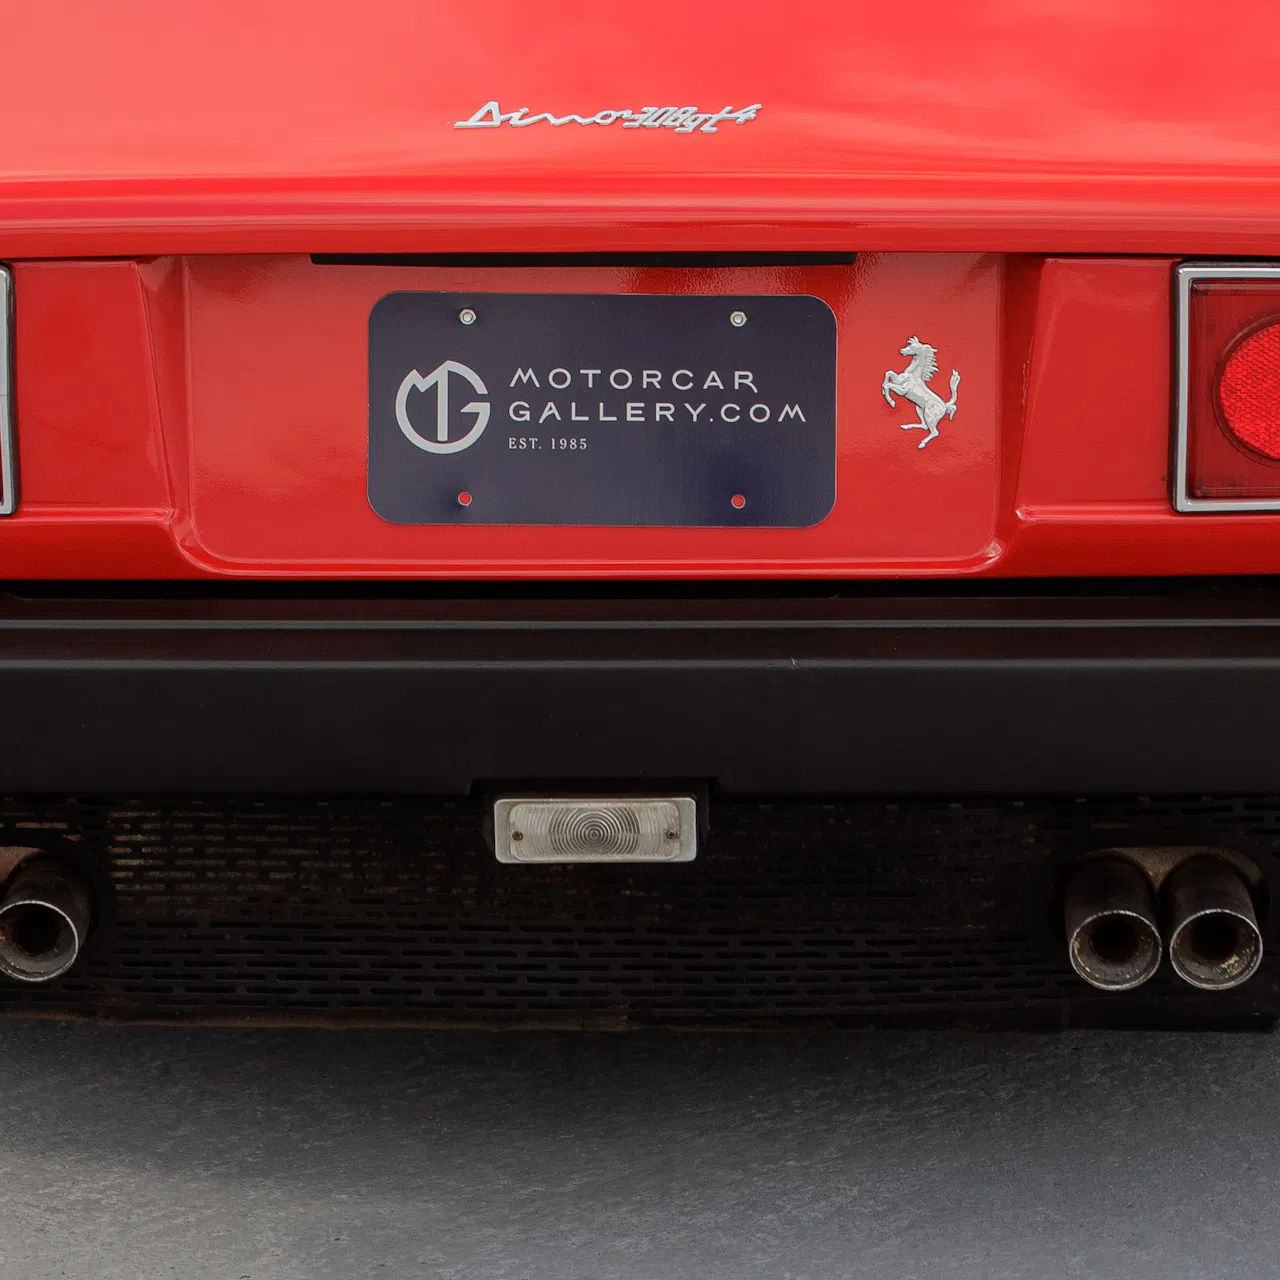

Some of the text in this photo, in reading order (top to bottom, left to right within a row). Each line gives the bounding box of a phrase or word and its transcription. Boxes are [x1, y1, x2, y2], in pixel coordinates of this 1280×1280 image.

[509, 367, 759, 393] MOTORCAR
[508, 400, 806, 424] GALLERY.COM
[508, 437, 587, 450] EST. 1985
